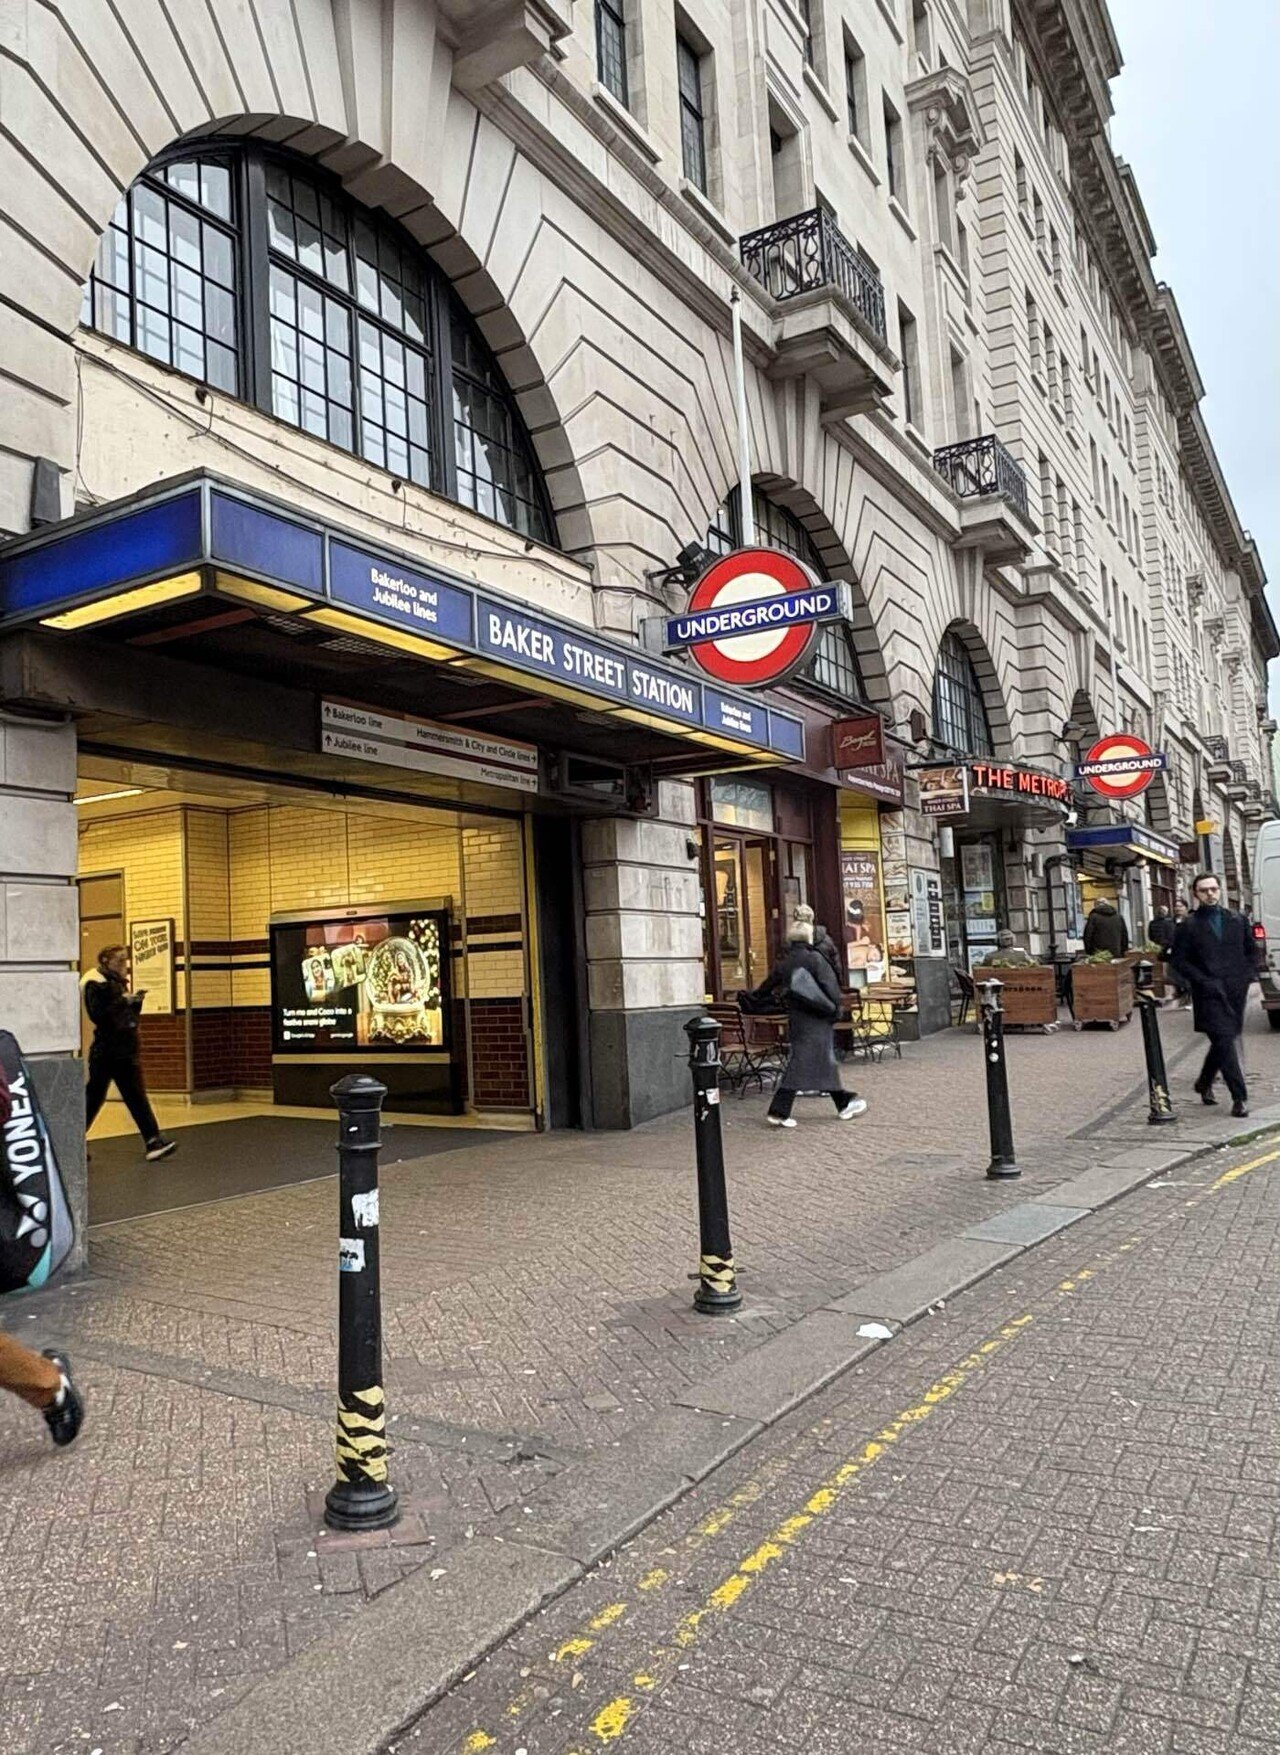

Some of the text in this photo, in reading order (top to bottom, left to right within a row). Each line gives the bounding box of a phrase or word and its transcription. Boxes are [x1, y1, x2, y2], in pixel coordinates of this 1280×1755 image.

[371, 568, 438, 606] Bakerloo and
[372, 588, 438, 622] Jubilee lines
[677, 594, 831, 638] UNDERGROUND
[489, 614, 693, 714] BAKER STREET STATION
[332, 708, 383, 730] Bakerloo line
[333, 736, 378, 756] Jubilee line
[416, 728, 464, 748] Hammersmith
[464, 738, 470, 748] &
[471, 740, 486, 754] City
[486, 744, 498, 754] and
[498, 746, 516, 760] Circle
[1078, 758, 1162, 775] UNDERGROUND
[973, 766, 1074, 804] THE METROP
[924, 802, 962, 812] THAI SPA
